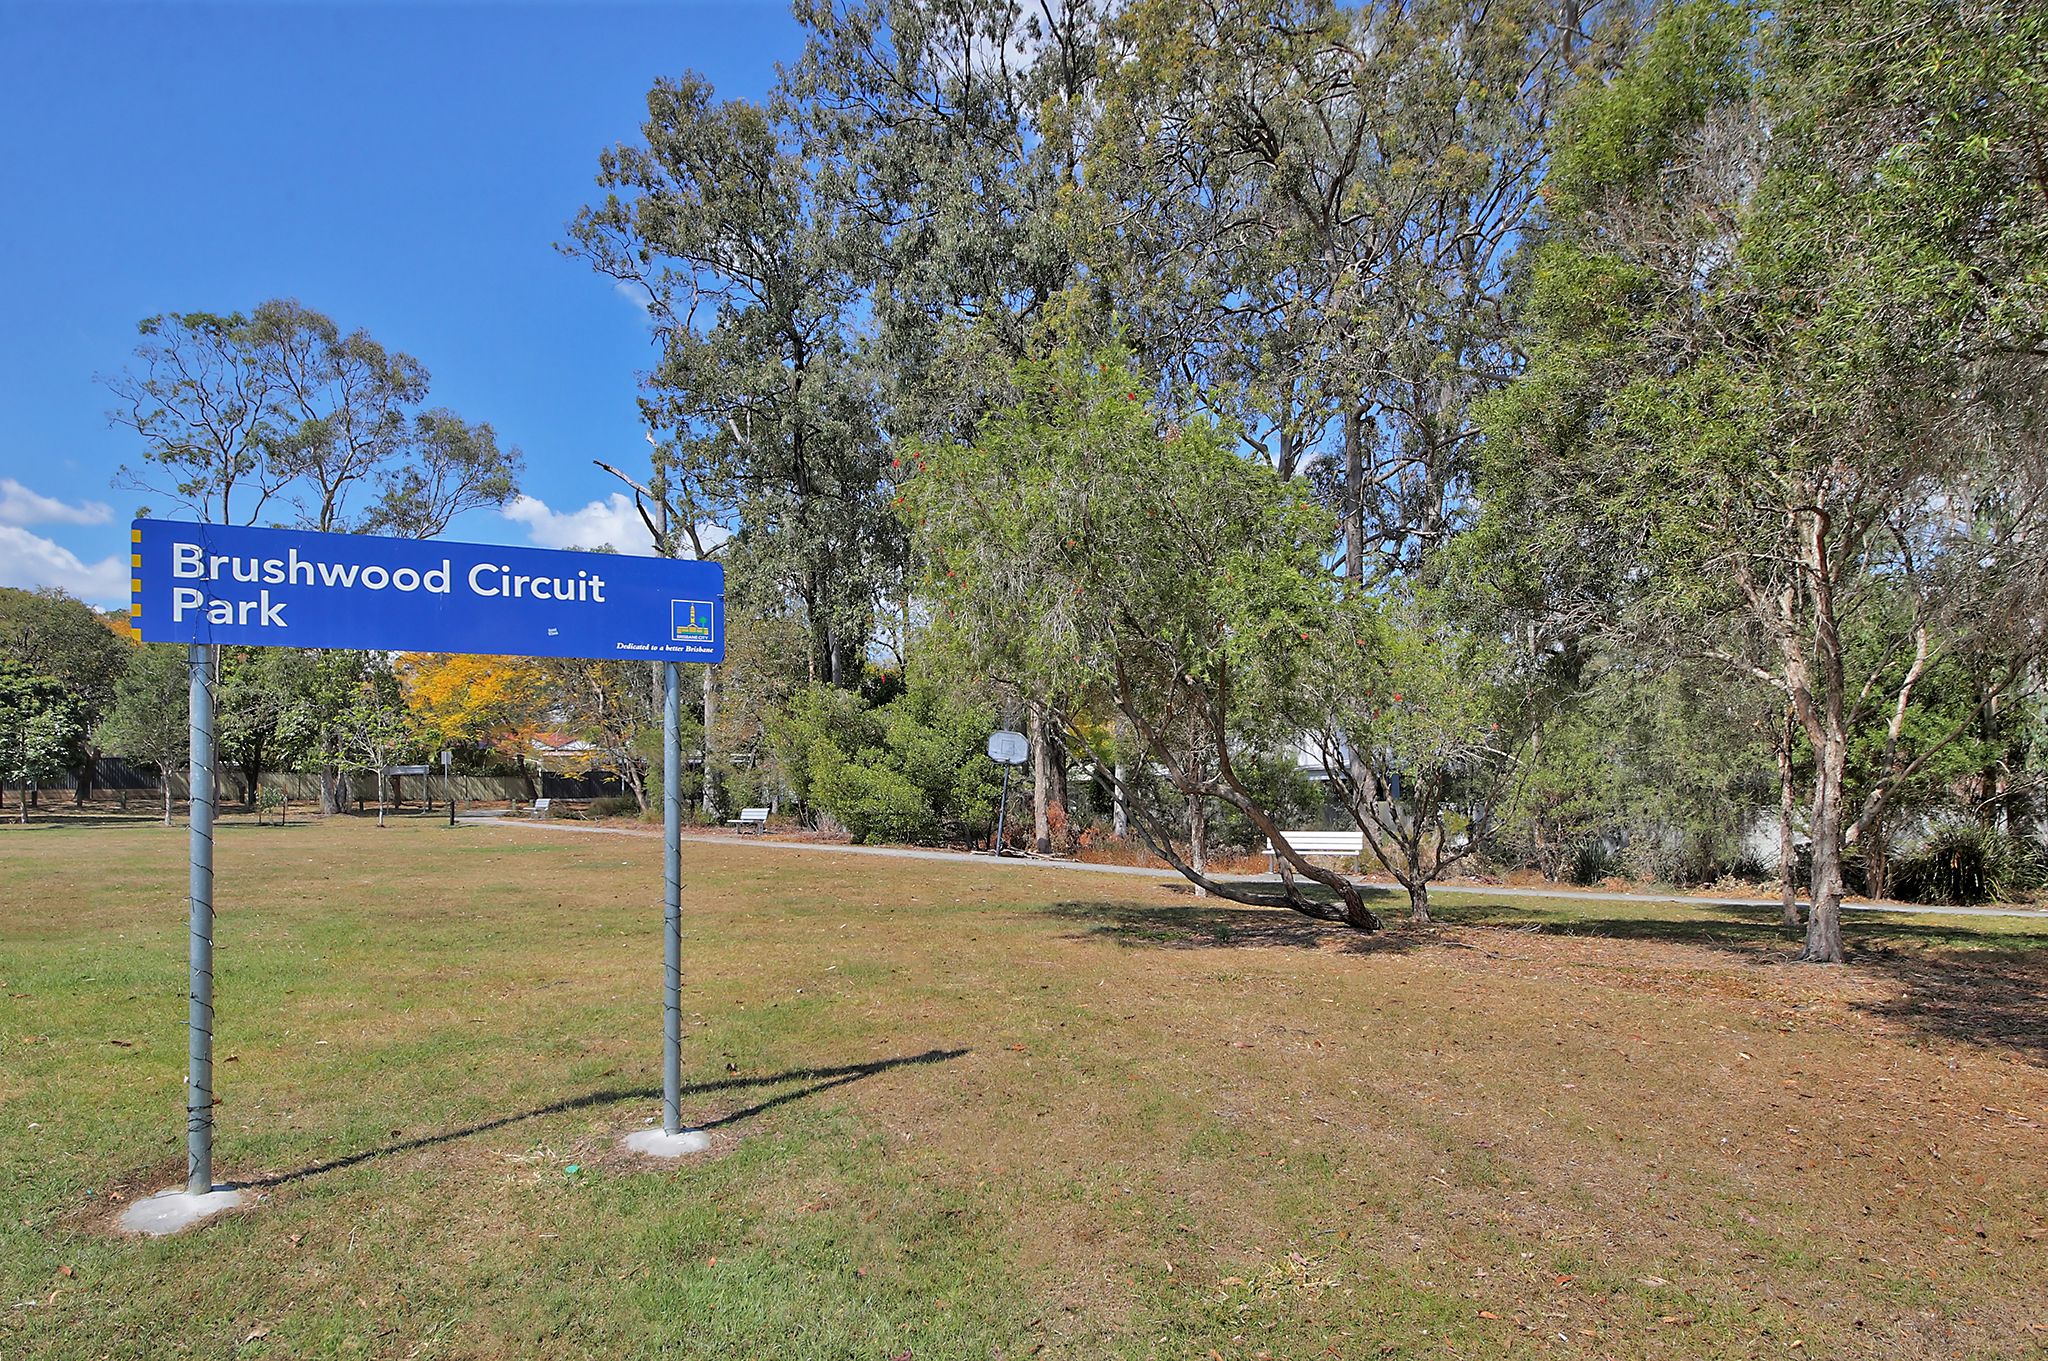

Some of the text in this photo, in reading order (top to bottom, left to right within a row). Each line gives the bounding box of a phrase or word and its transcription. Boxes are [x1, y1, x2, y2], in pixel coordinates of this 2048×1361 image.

[173, 542, 606, 603] Brushwood Circuit
[173, 587, 288, 628] Park
[617, 642, 650, 651] Dedicated
[666, 644, 684, 652] better
[686, 645, 714, 653] Brisbane
